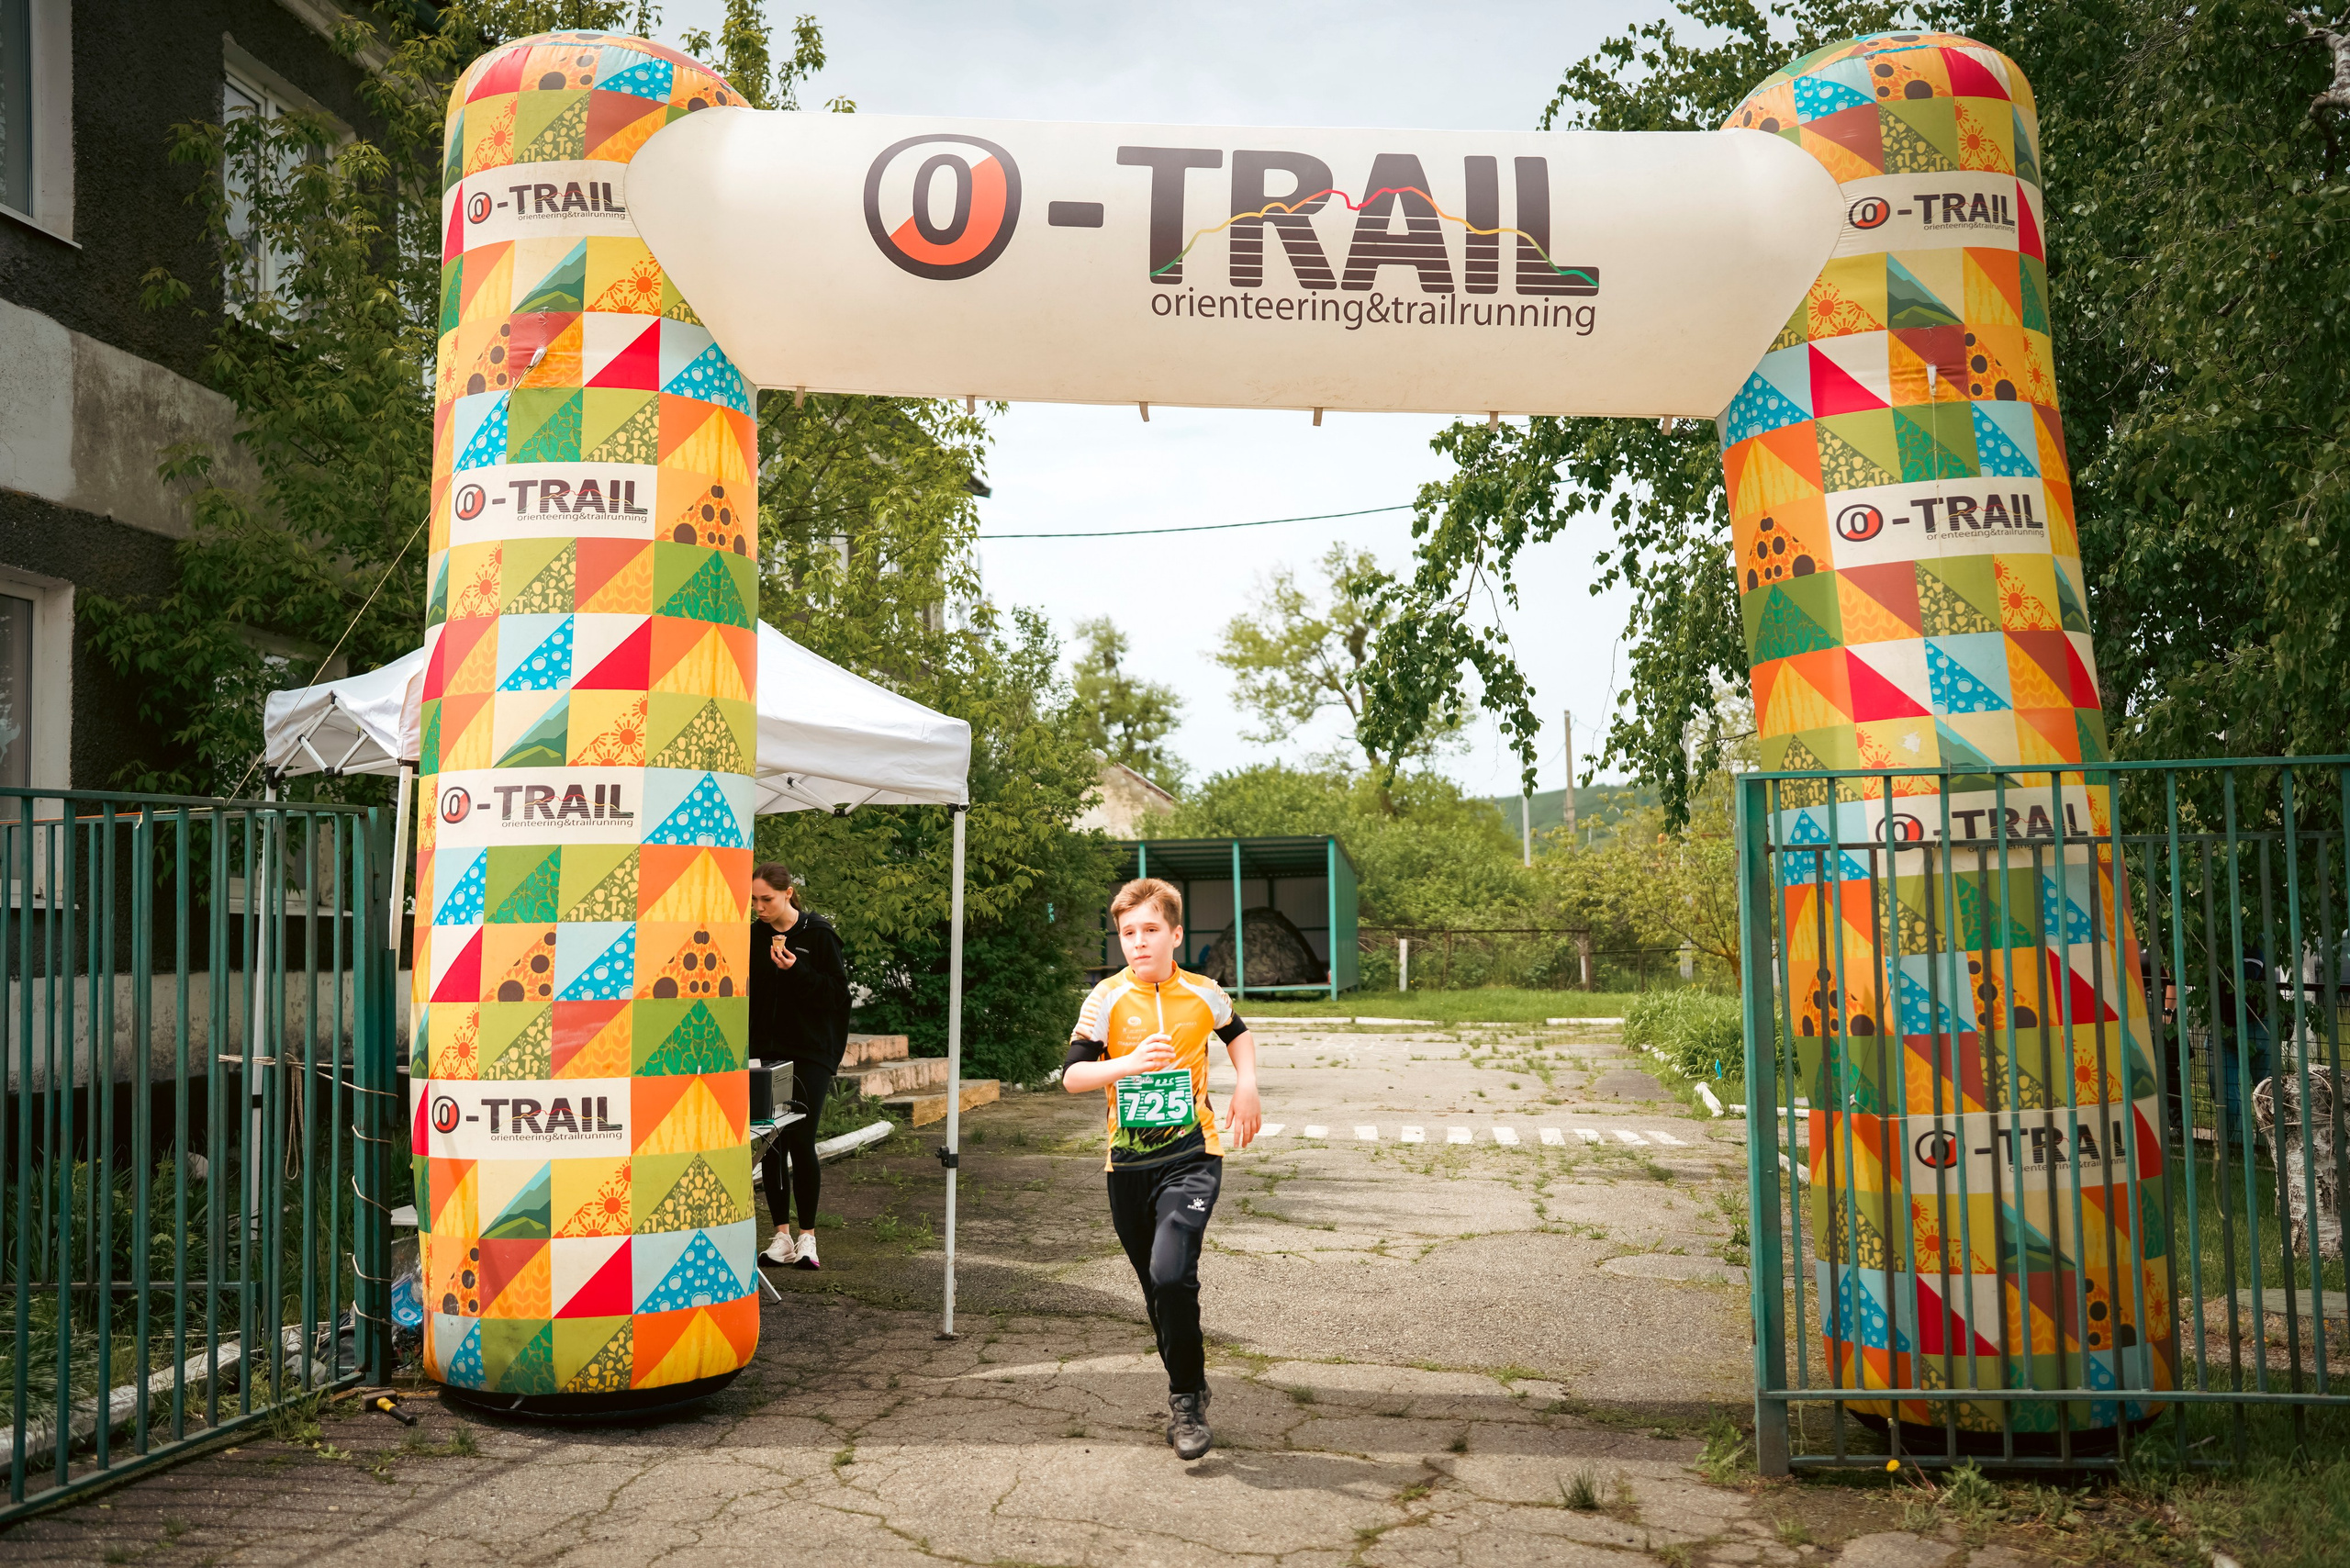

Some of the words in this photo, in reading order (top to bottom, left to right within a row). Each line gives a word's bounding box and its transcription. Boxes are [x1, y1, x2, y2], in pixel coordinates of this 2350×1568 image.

[518, 210, 626, 220] orienteering&trailrunning
[1923, 221, 2016, 234] orienteering&trailrunning
[1150, 286, 1596, 336] orienteering&trailrunning
[517, 512, 648, 523] orienteering&trailrunning
[1926, 528, 2044, 541] orenteering&trailrunning
[501, 818, 634, 829] orienteering&trailrunning
[1124, 1090, 1189, 1121] 725
[490, 1132, 623, 1142] orienteering&trailrunning
